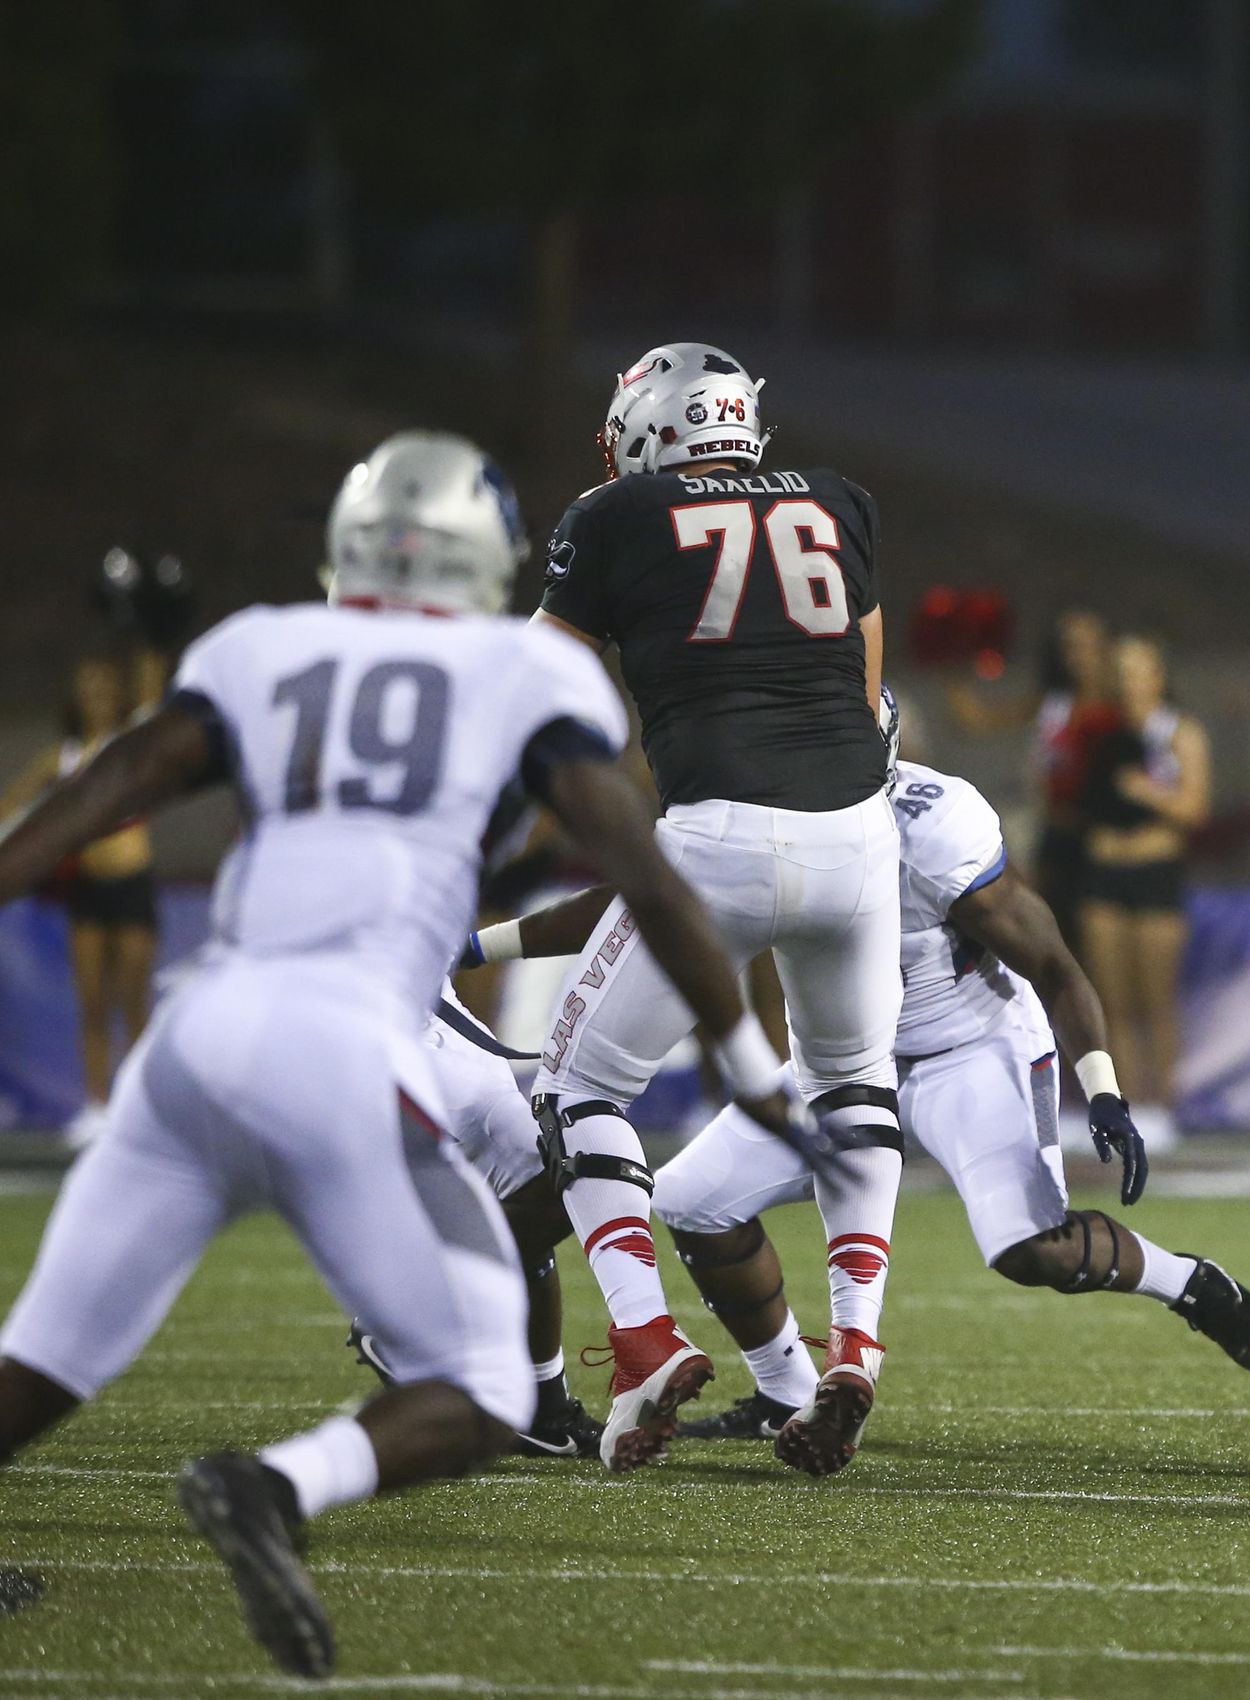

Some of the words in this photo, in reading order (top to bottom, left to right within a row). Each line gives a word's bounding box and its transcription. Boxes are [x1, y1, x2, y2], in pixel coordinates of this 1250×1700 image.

[687, 439, 760, 457] REBELS
[669, 500, 851, 642] 76
[271, 655, 452, 815] 19
[895, 783, 945, 820] 46
[543, 990, 587, 1075] LAS
